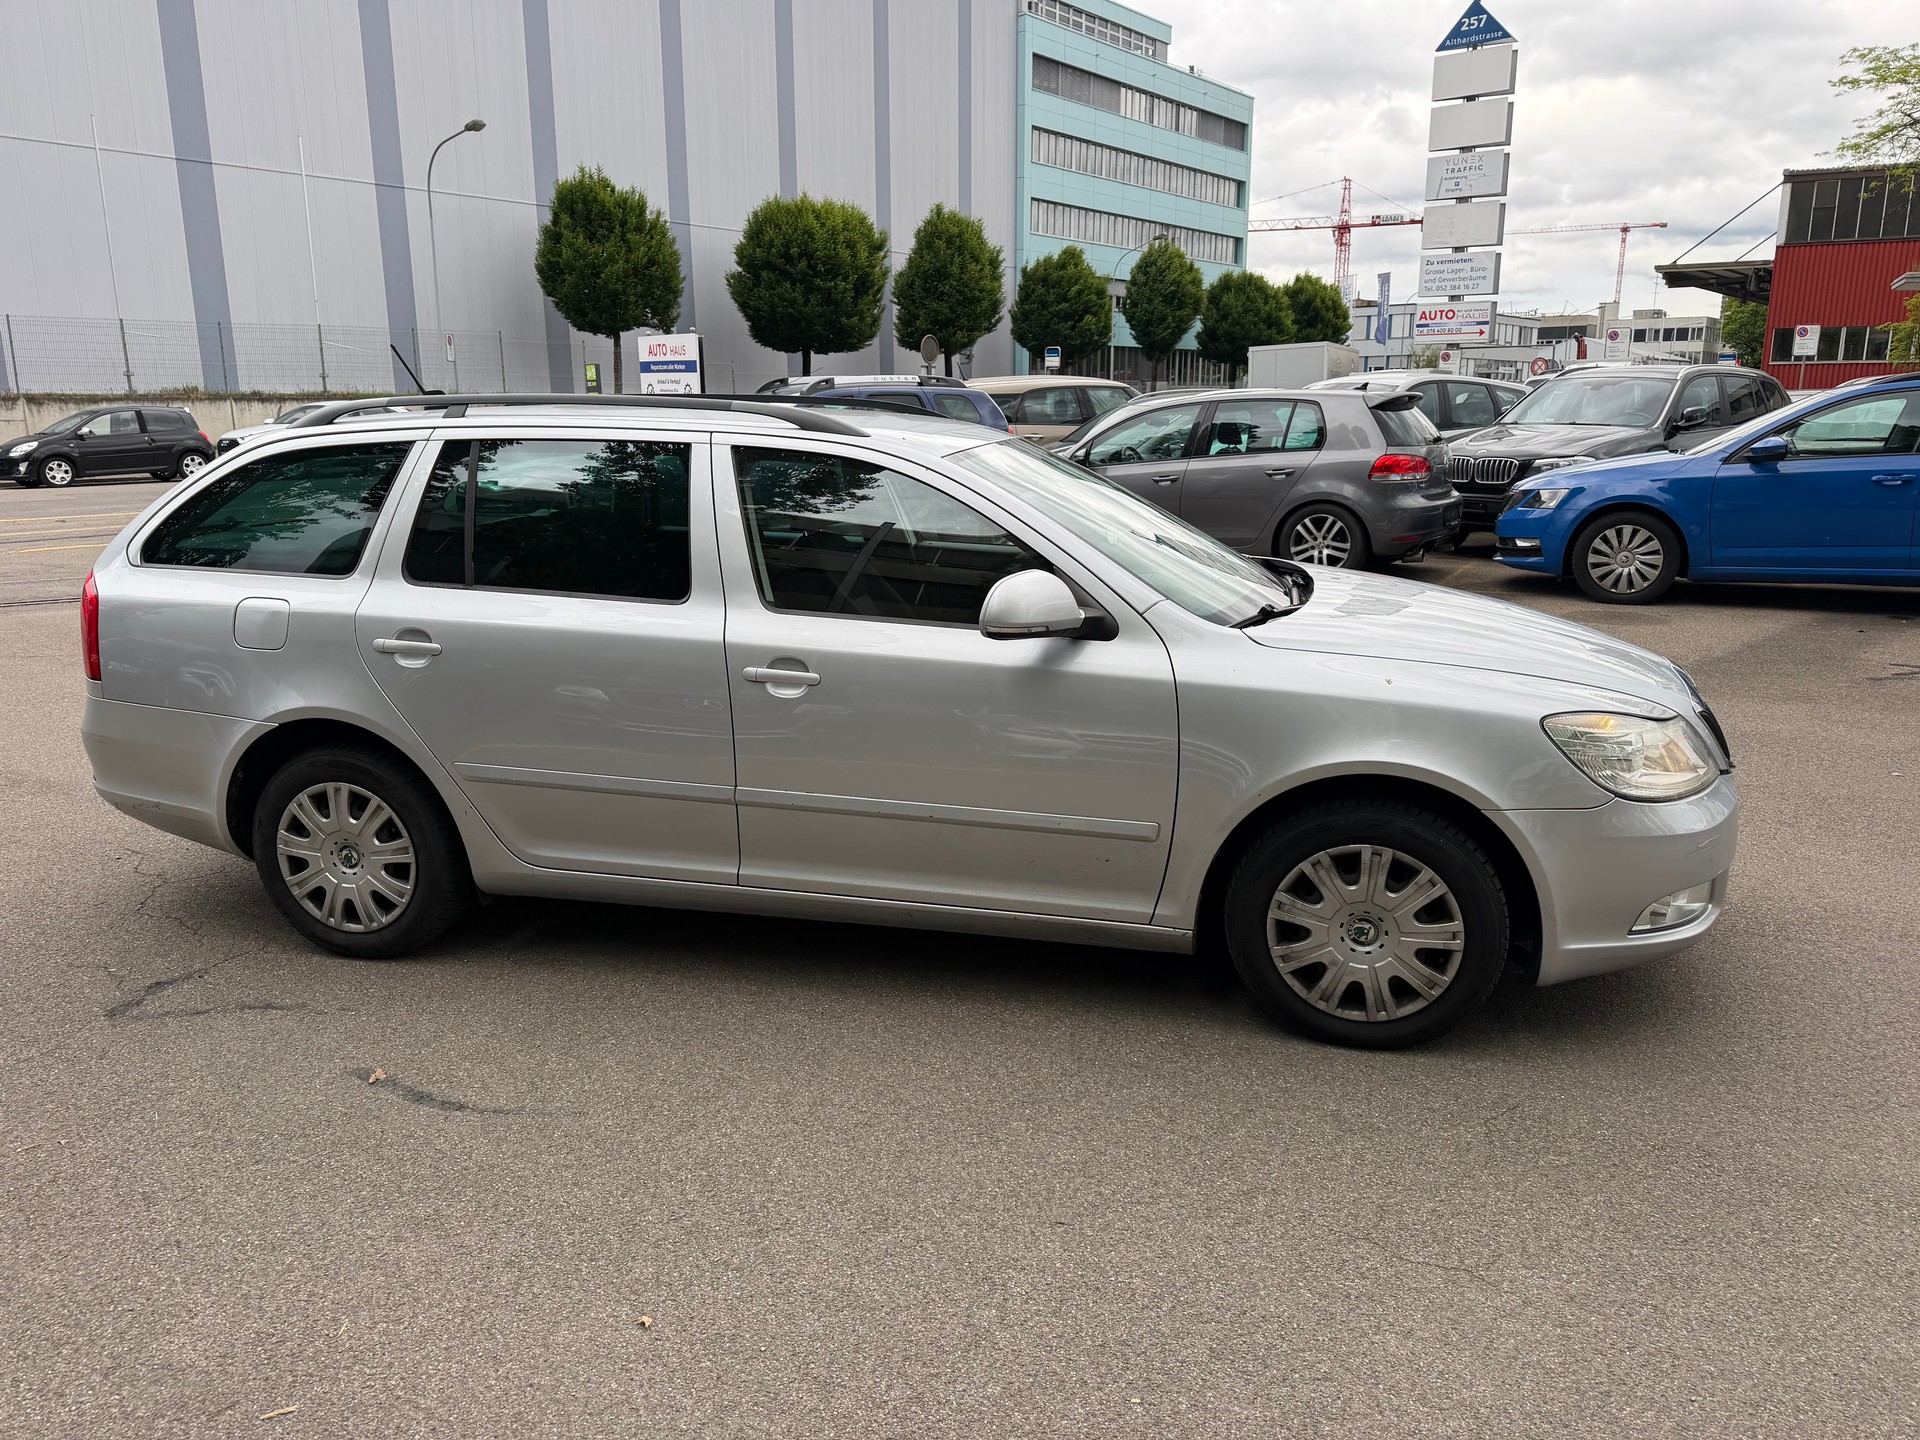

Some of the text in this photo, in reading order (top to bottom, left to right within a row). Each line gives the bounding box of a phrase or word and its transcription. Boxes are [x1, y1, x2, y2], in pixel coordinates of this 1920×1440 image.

[1461, 14, 1488, 31] 257
[1445, 30, 1503, 46] Althardstrasse
[1445, 154, 1484, 166] YUNEX
[1445, 164, 1484, 174] TRAFFIC
[1436, 257, 1475, 265] vermieten:
[1424, 265, 1488, 276] Grosse Lager-, Büro-
[1437, 274, 1487, 283] Gewerberäume
[1419, 309, 1489, 321] AUTO HAUS
[648, 343, 687, 357] AUTO HAUS
